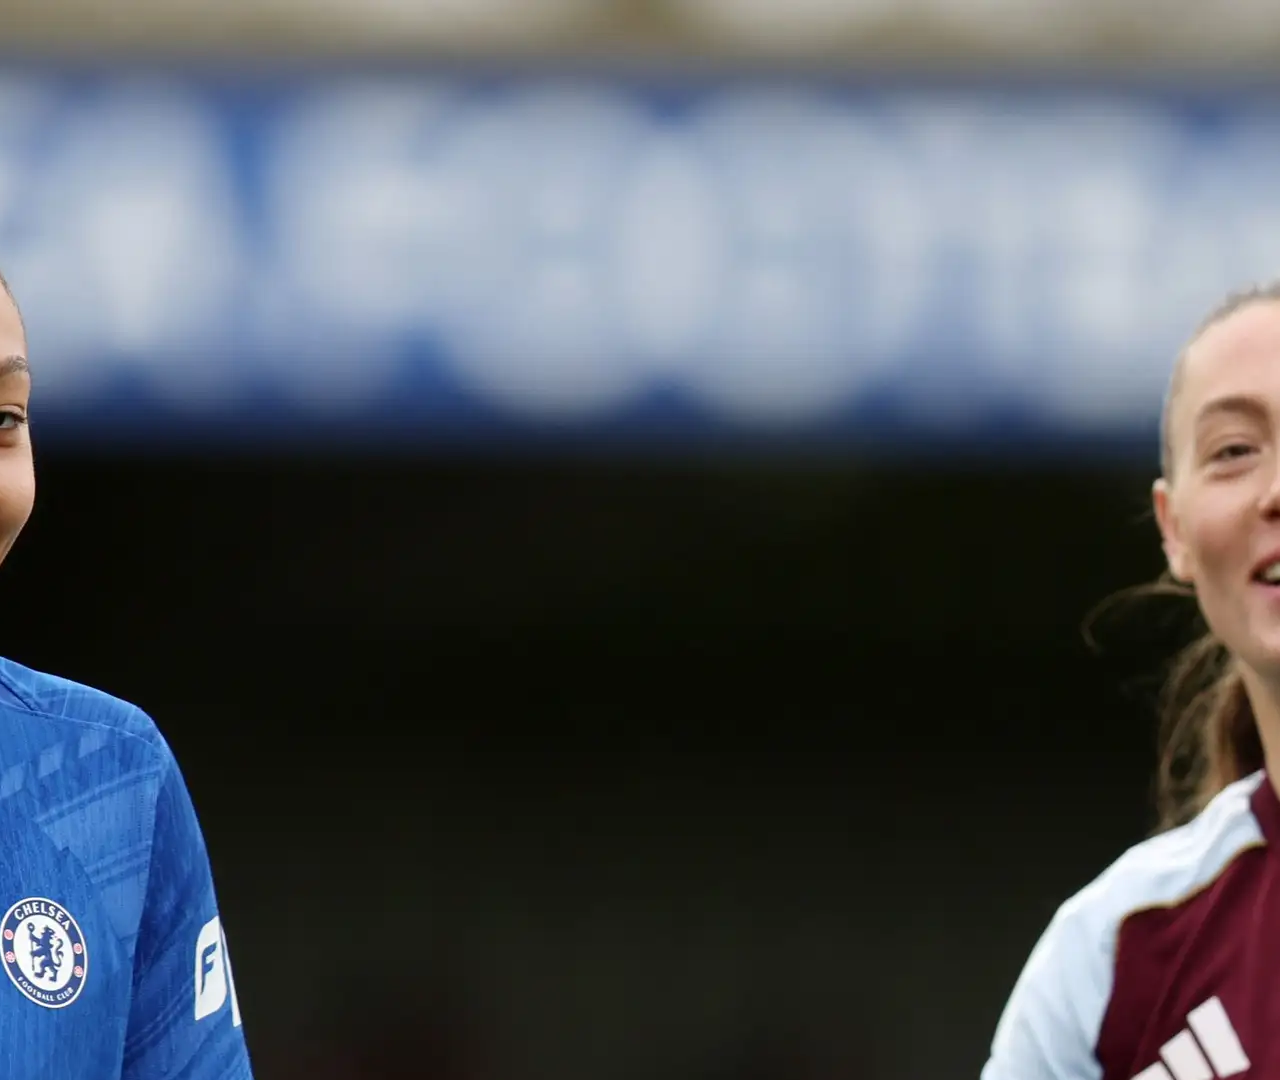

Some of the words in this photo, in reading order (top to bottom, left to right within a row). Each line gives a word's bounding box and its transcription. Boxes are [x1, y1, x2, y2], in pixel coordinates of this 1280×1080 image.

[14, 902, 71, 930] CHELSEA
[17, 976, 55, 1001] FOOTBALL
[56, 986, 74, 1001] CLUB
